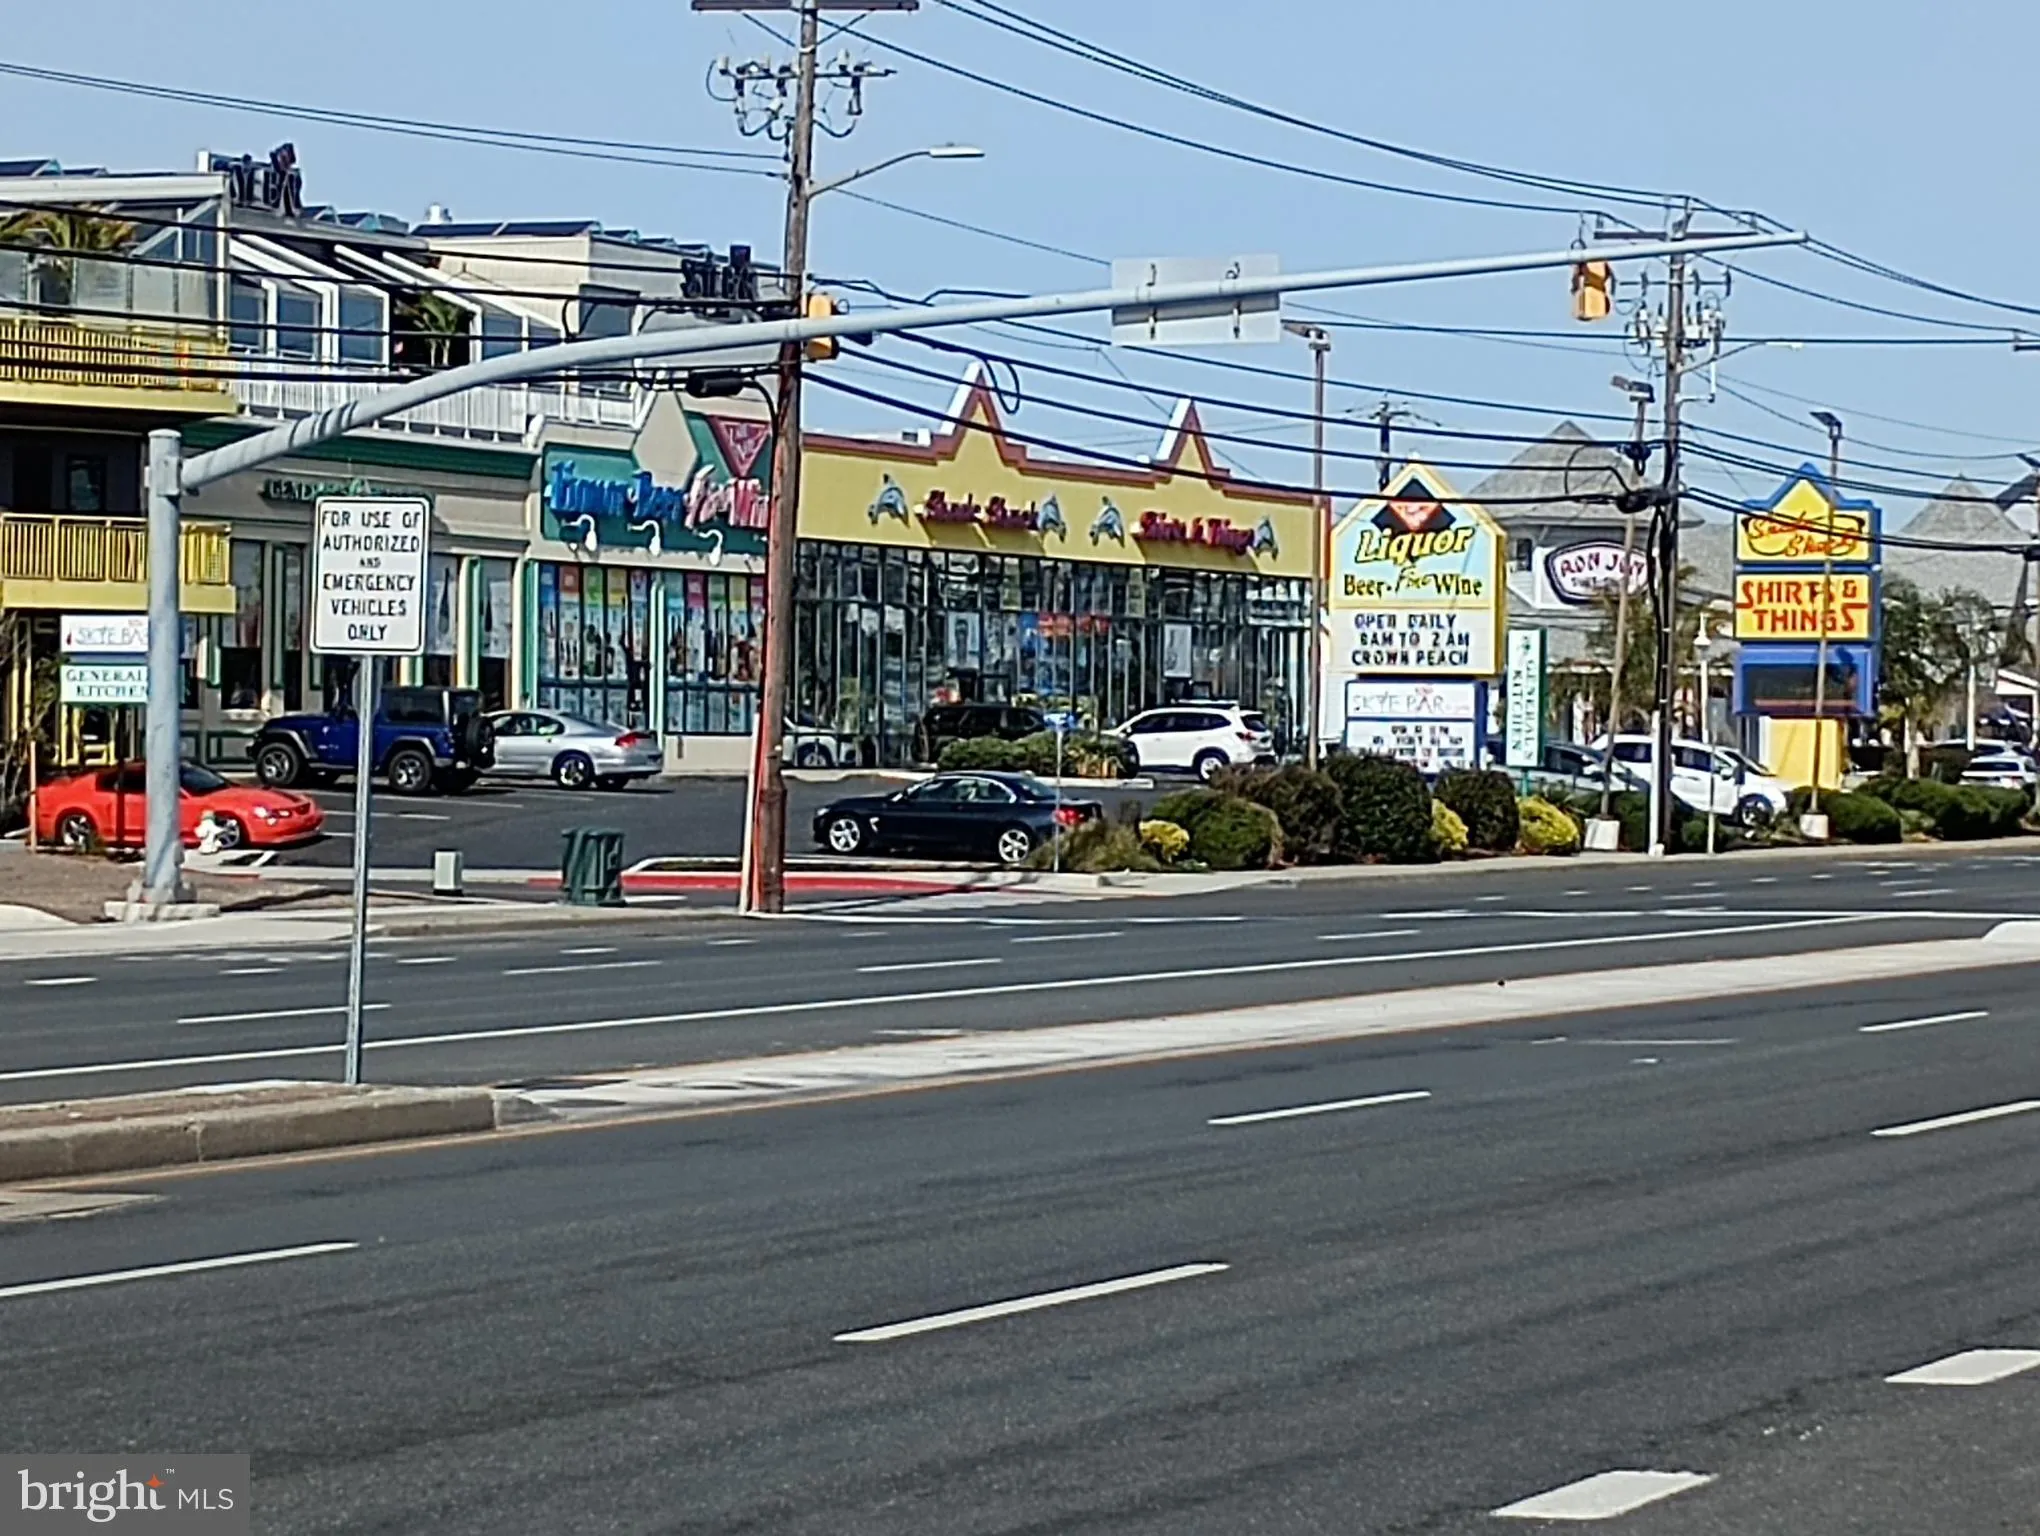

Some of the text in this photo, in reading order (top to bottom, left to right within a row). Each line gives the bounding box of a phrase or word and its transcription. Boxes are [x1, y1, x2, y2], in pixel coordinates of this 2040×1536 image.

[322, 511, 421, 528] FOR USE OF
[323, 534, 420, 552] AUTHORIZED
[1355, 526, 1475, 566] Liquor
[359, 557, 381, 567] AND
[1560, 552, 1600, 577] RON
[323, 573, 415, 591] EMERGENCY
[1426, 574, 1482, 595] Wine
[1735, 580, 1857, 609] SHIRTS &
[331, 599, 406, 616] VEHICLES
[1355, 614, 1456, 630] OPEN DAILY
[1753, 603, 1871, 633] THINGS
[348, 624, 387, 641] ONLY
[1399, 632, 1420, 647] TO
[1433, 632, 1440, 646] 2
[1446, 632, 1470, 647] AM
[1352, 650, 1468, 667] CROWN PEACH
[1513, 670, 1523, 750] KITCHEN
